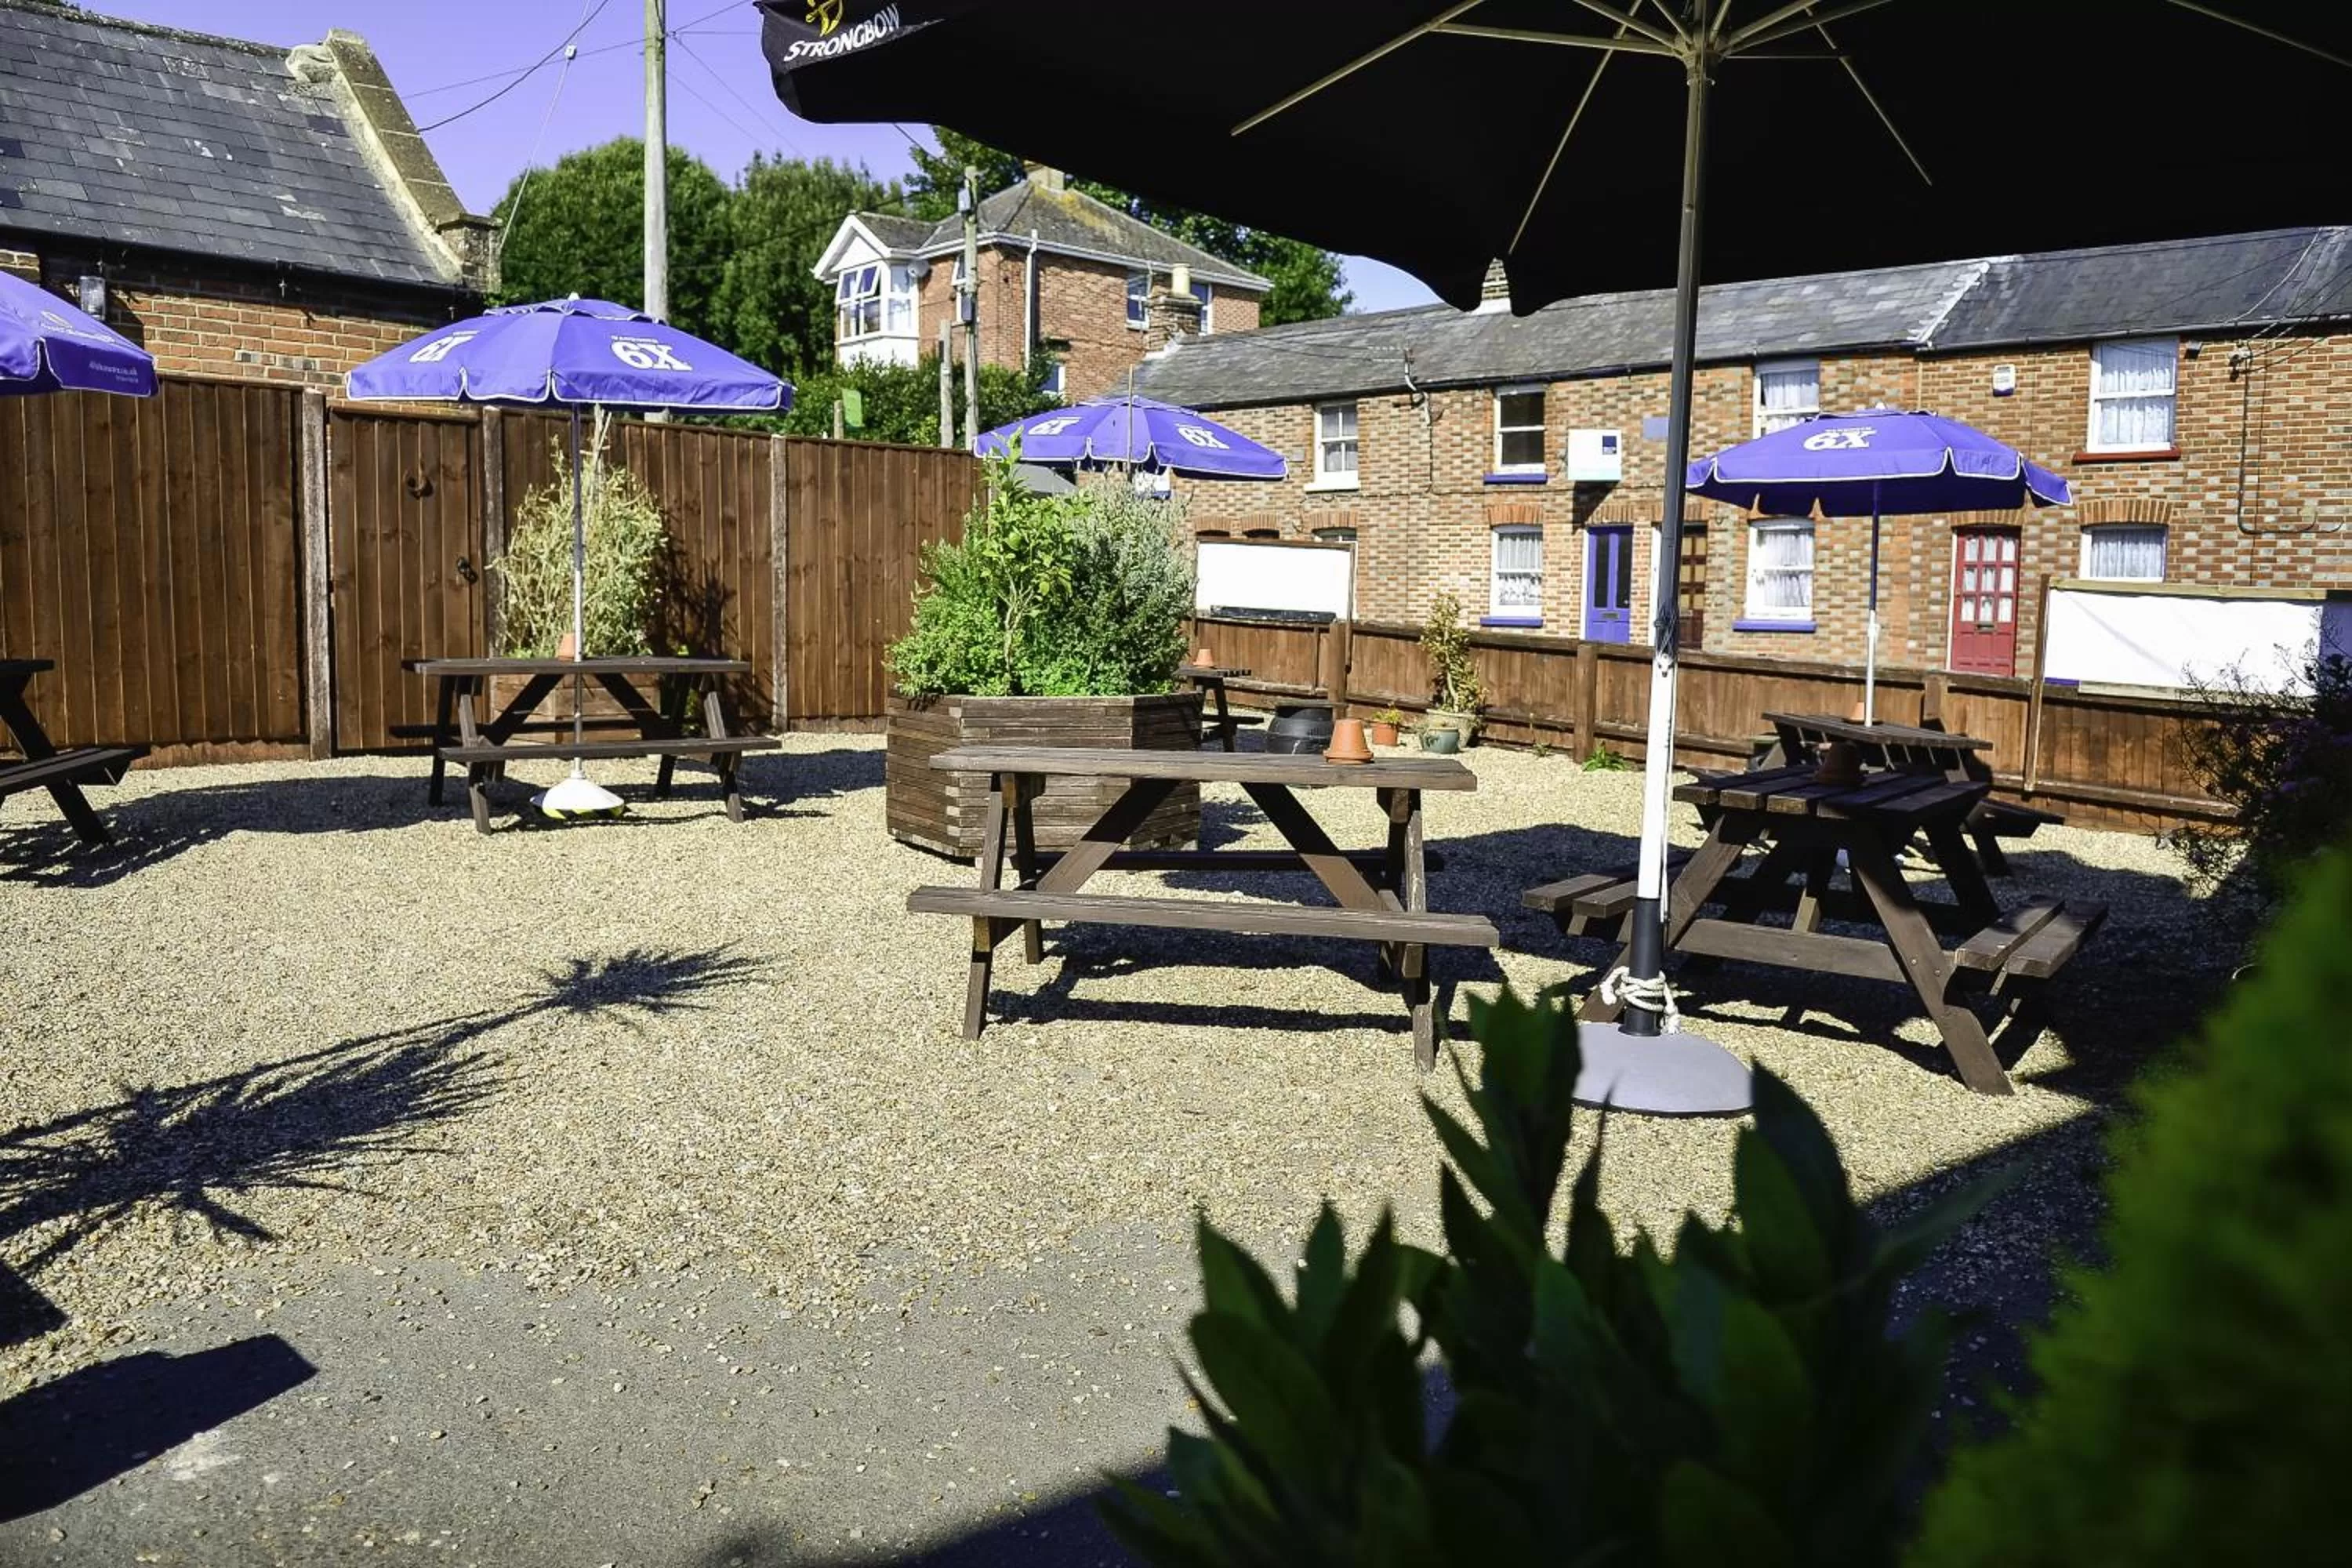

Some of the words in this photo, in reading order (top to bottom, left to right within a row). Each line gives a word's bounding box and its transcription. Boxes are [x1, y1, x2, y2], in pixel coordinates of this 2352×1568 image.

[783, 3, 899, 61] STRONGBOW
[612, 342, 693, 370] 6X
[1178, 428, 1230, 449] 6X
[1803, 430, 1877, 451] 6X
